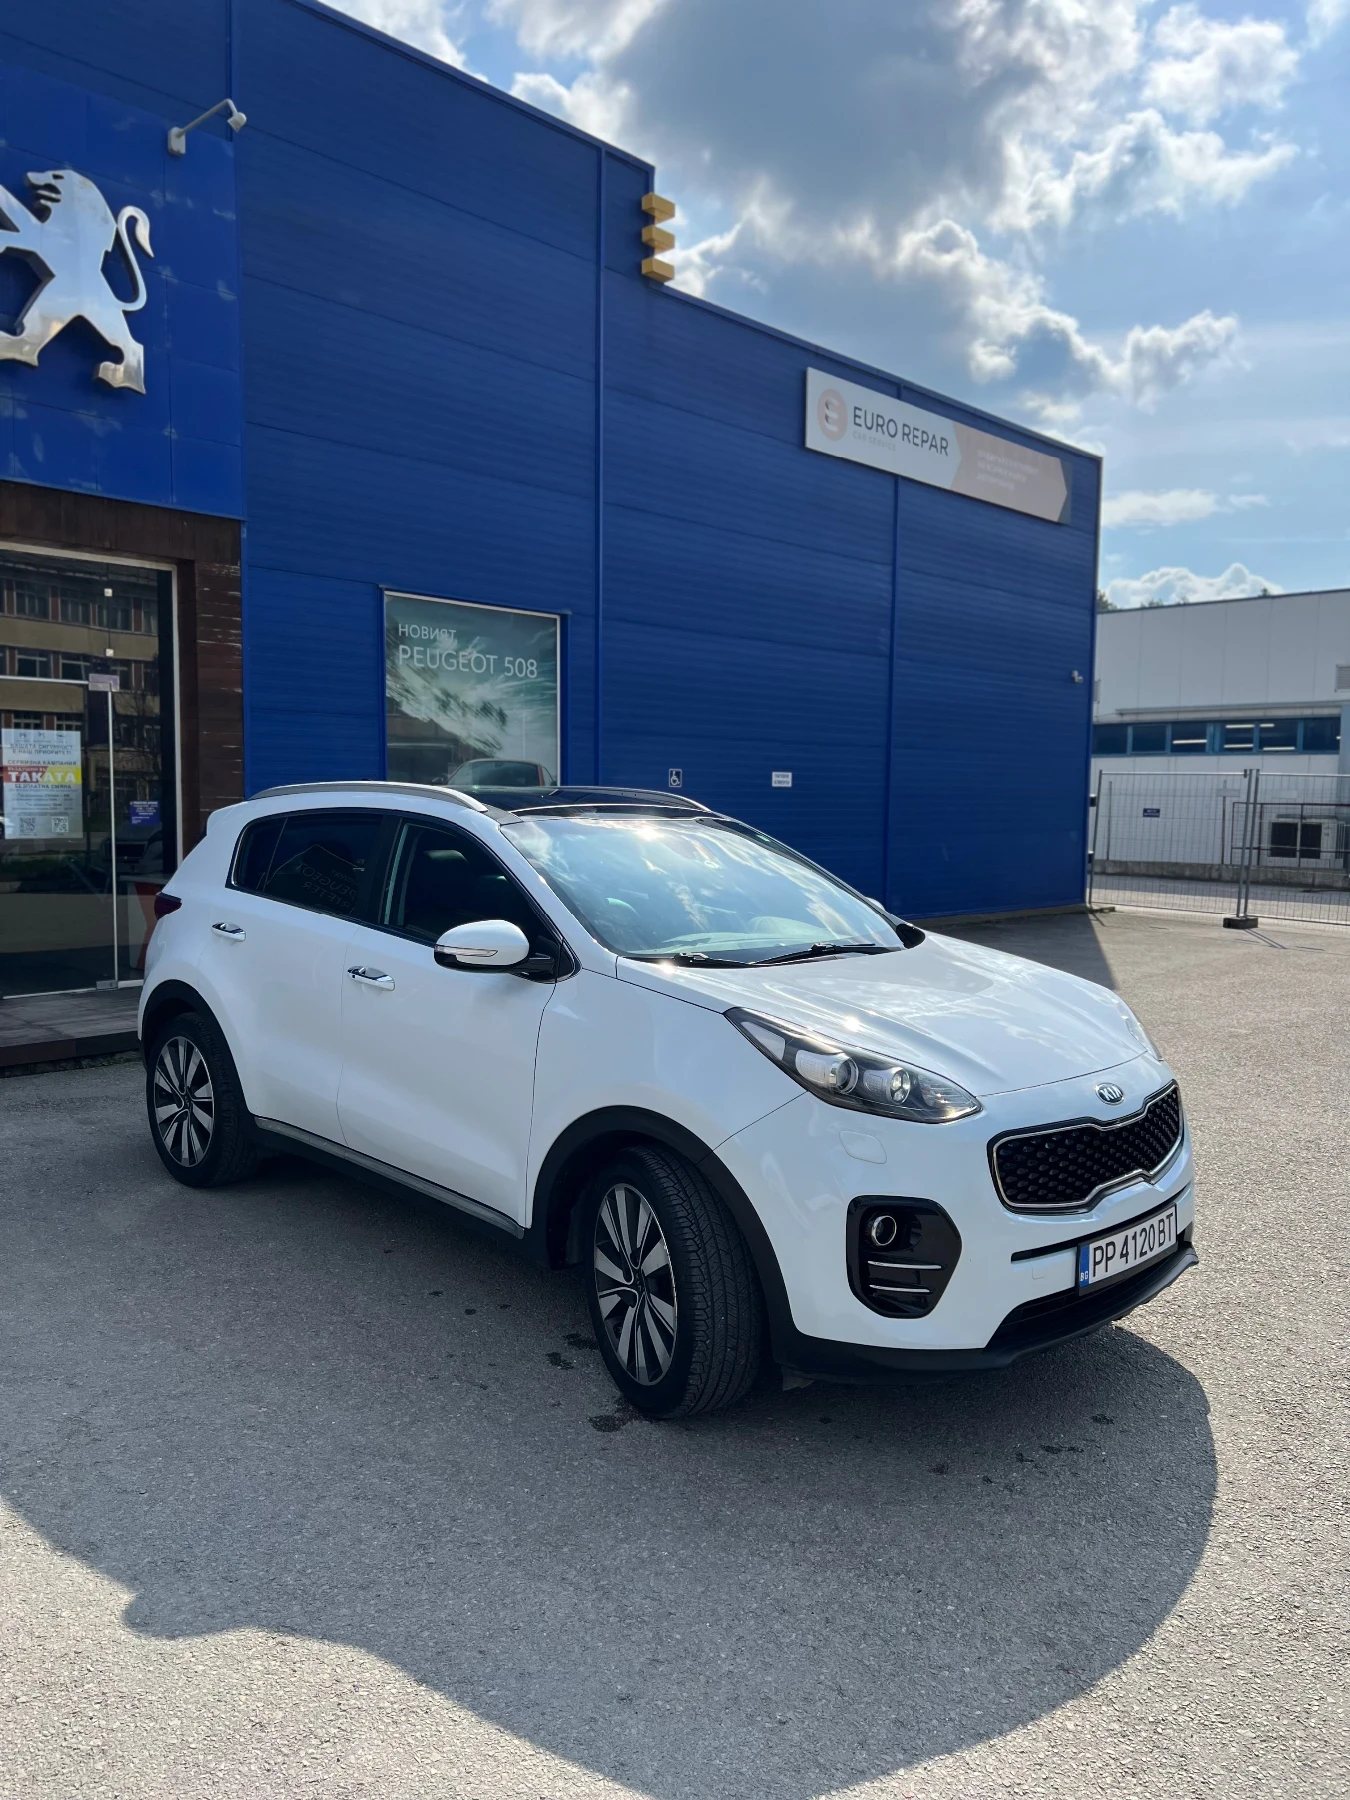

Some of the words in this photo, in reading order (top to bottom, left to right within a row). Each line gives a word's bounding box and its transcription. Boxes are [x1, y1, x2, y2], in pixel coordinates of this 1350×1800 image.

[853, 405, 898, 439] EURO
[902, 423, 949, 456] REPAR
[398, 623, 457, 641] НОВИЯТ
[398, 645, 498, 675] PEUGEOT
[504, 657, 538, 679] 508
[1099, 1085, 1123, 1101] KIA
[1080, 1271, 1088, 1282] BG
